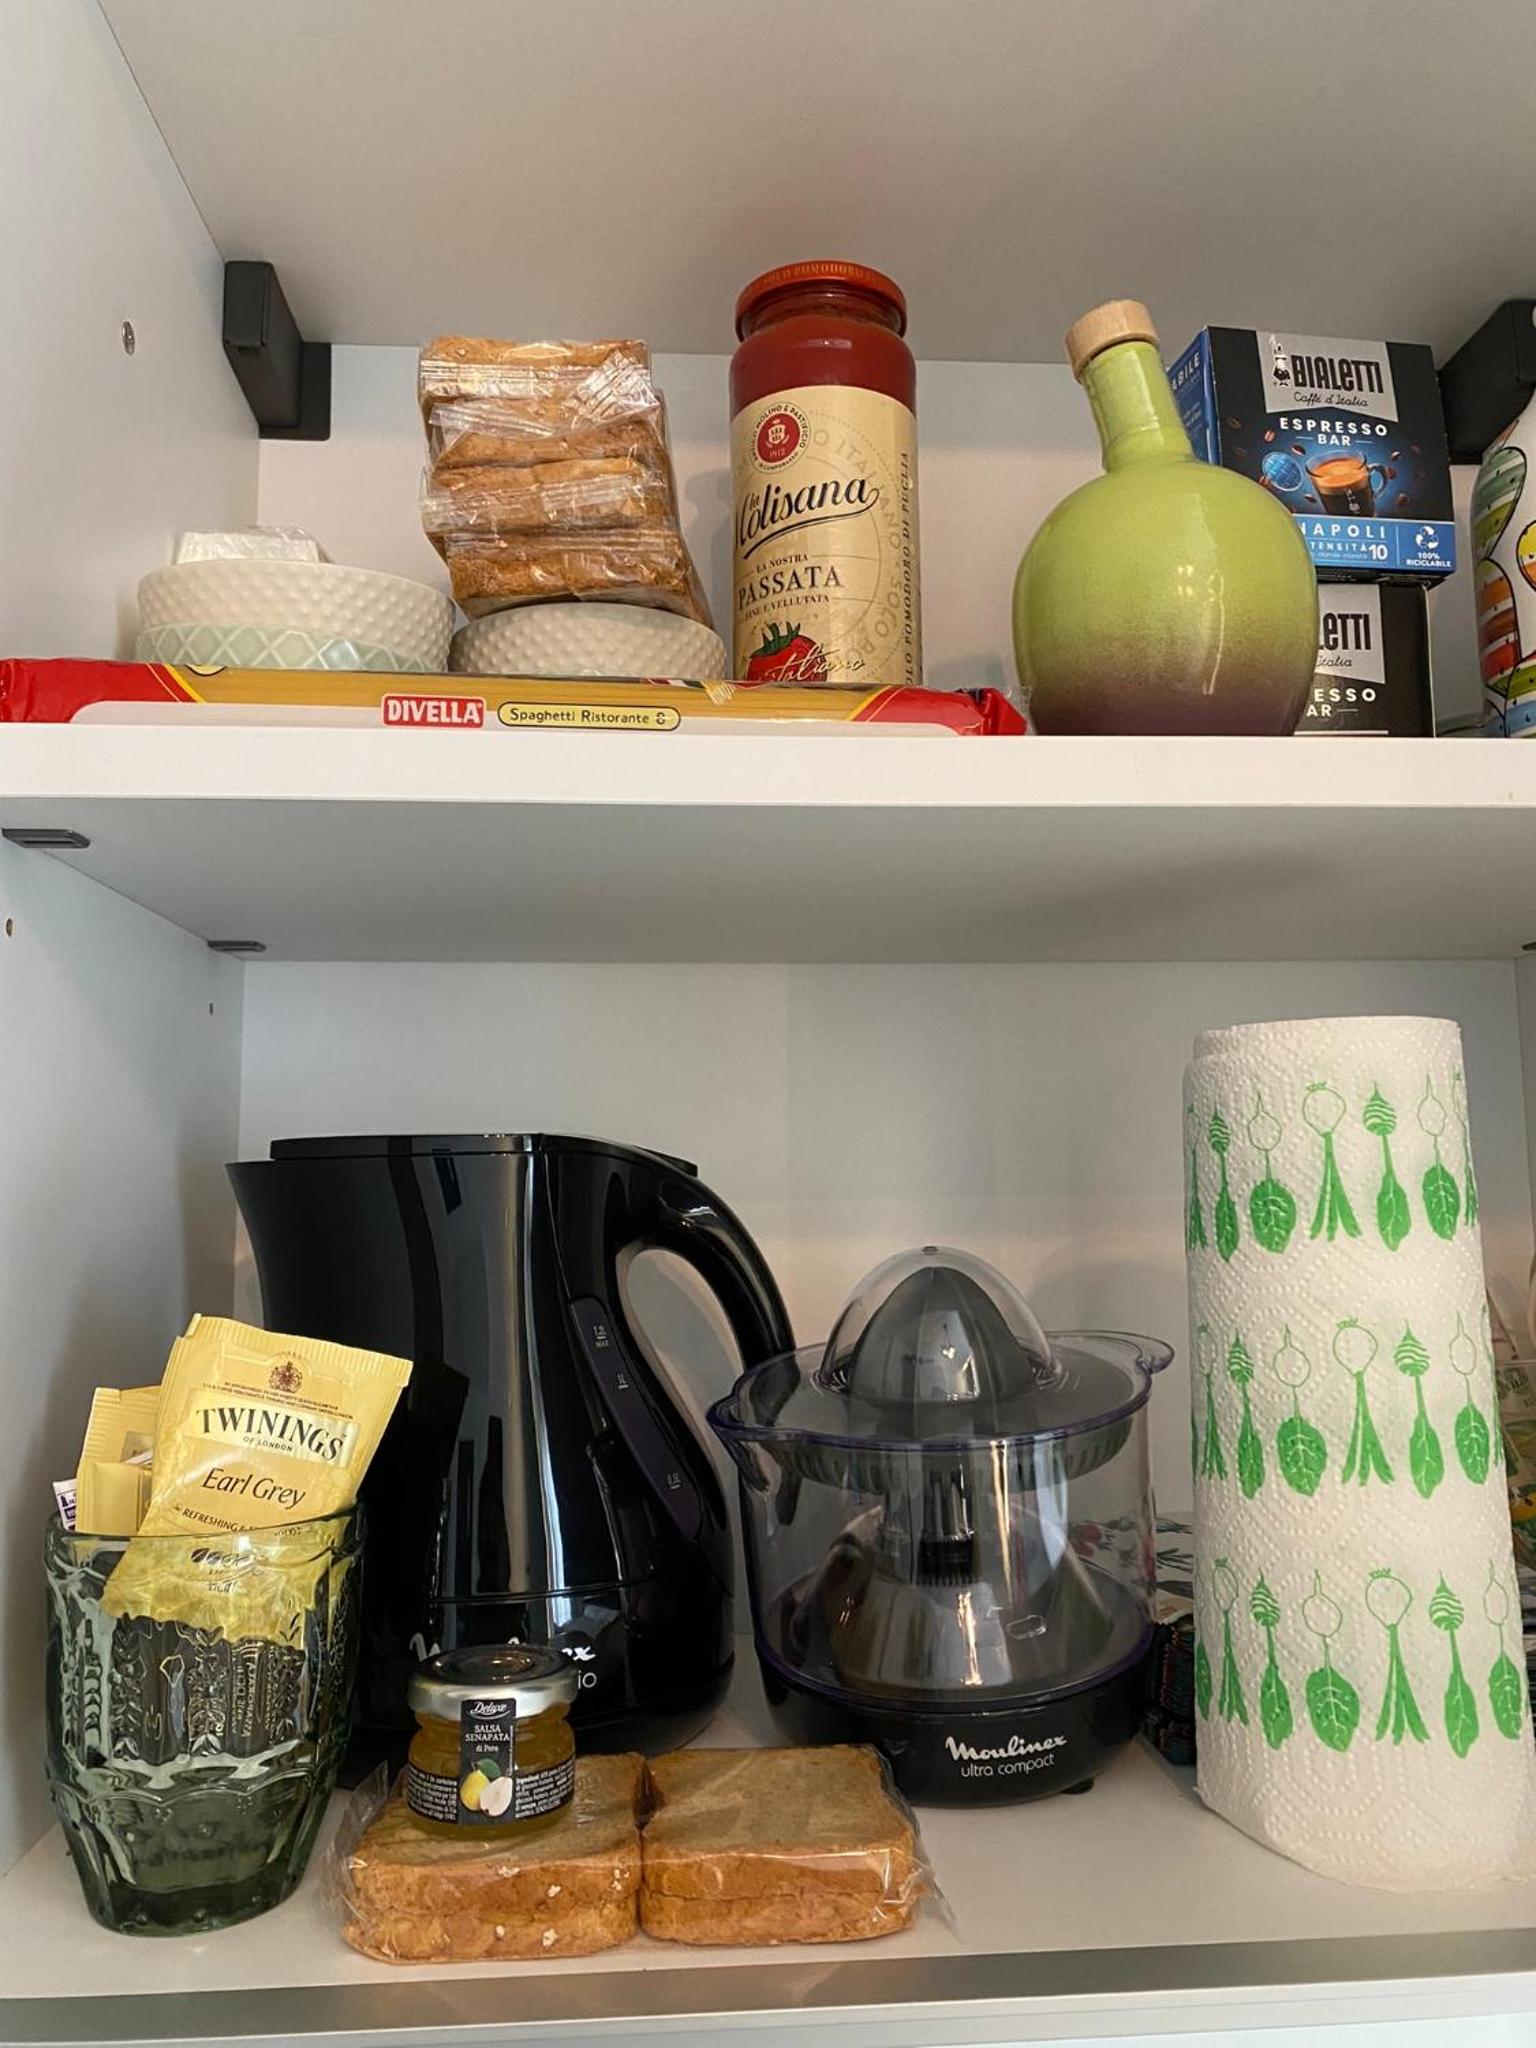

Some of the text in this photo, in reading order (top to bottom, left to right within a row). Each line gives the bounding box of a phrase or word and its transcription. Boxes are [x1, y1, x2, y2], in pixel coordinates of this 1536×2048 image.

[1279, 416, 1388, 437] ESPRESSO
[1317, 433, 1351, 447] BAR
[769, 553, 808, 568] NOSTRA
[1368, 543, 1388, 561] 10
[1417, 551, 1440, 560] 100%
[1406, 558, 1452, 568] RICICLABILE
[738, 564, 845, 610] PASSATA
[386, 698, 480, 724] DIVELLA
[510, 707, 575, 723] Spaghetti
[581, 709, 649, 724] Ristorante
[195, 1407, 344, 1461] TWININGS
[243, 1436, 293, 1452] OF LONDON
[201, 1467, 306, 1510] Earl Grey
[182, 1508, 239, 1532] REFRESHING
[465, 1733, 511, 1742] SENAPATA
[474, 1724, 502, 1733] SALSA
[945, 1735, 1068, 1761] Moulinex
[961, 1753, 1055, 1778] ultra compact
